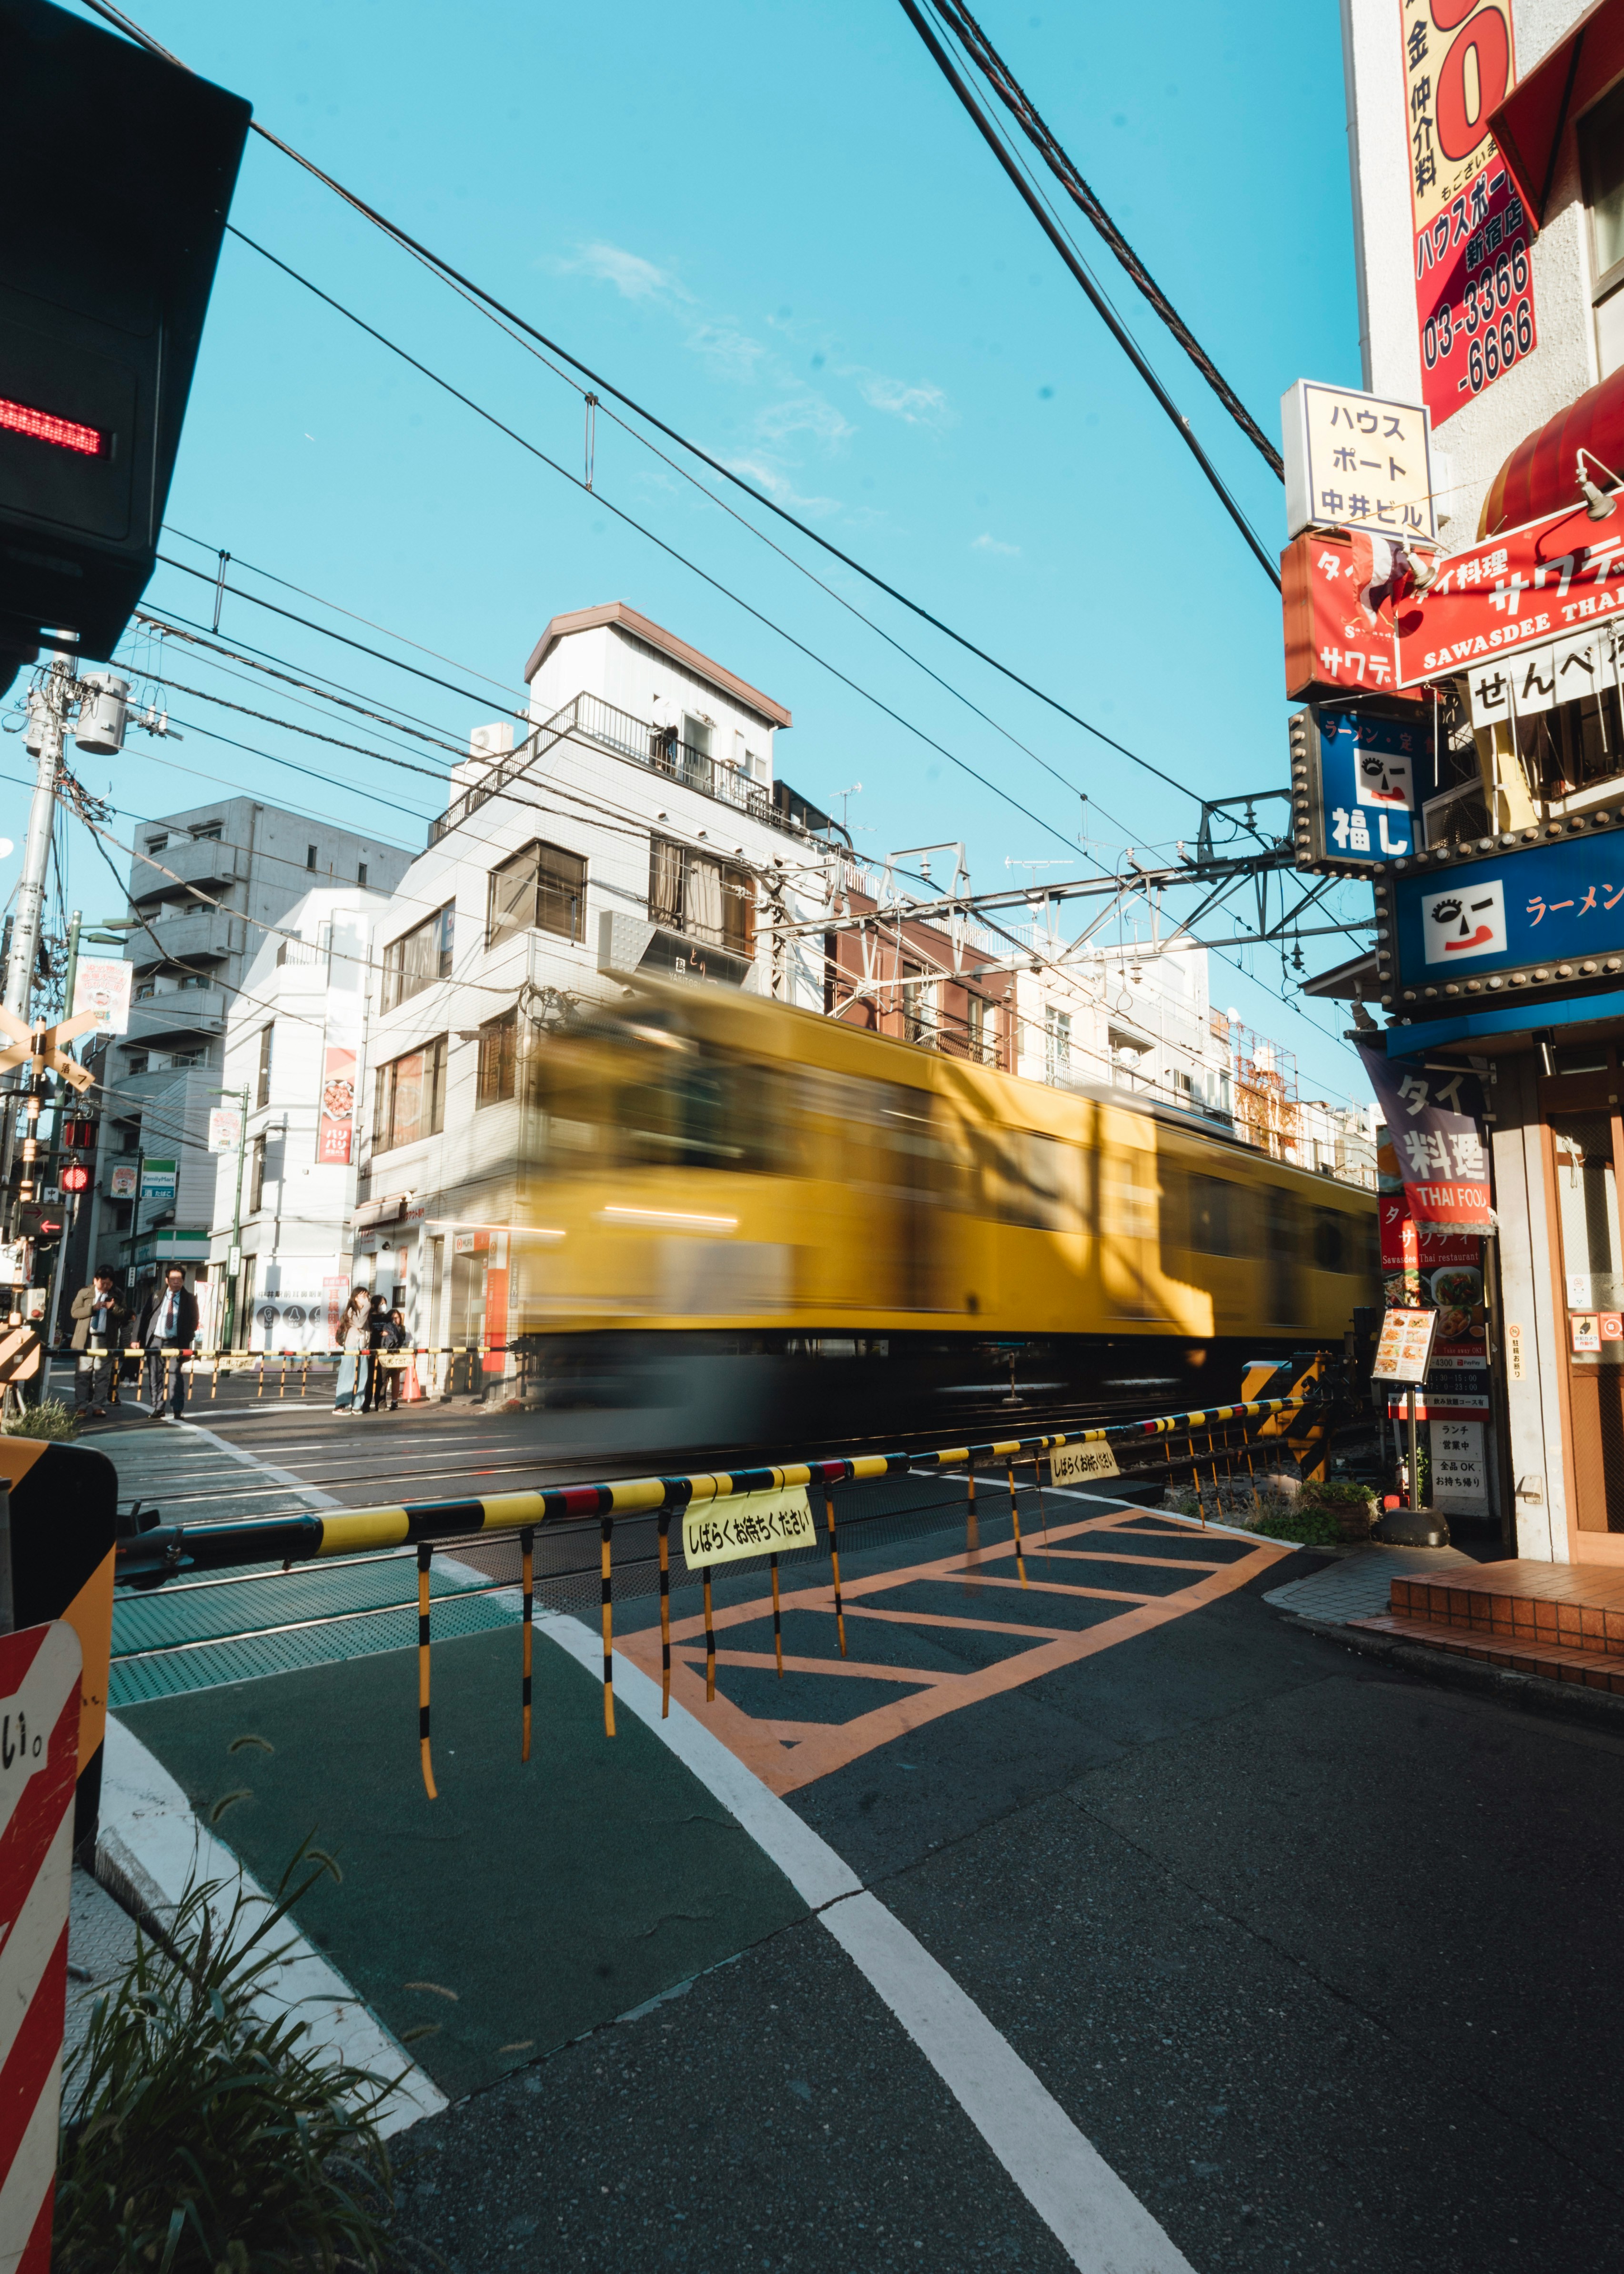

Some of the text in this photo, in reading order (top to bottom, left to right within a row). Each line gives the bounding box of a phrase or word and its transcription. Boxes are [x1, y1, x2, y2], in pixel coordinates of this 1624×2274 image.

[1466, 197, 1523, 273] 新宿店
[1424, 238, 1528, 370] 03-3366
[1458, 297, 1533, 394] -6666
[1331, 405, 1406, 441] ハウス
[1333, 446, 1407, 482] ポート
[1321, 489, 1423, 528] 中井ビル
[1317, 551, 1353, 581] タ
[1423, 613, 1551, 669] SAWASDEE
[1526, 884, 1624, 927] ラーメン
[669, 972, 701, 989] YAKITORI
[1397, 1074, 1464, 1116] タイ
[1403, 1131, 1485, 1180] 料理
[1417, 1187, 1455, 1206] THAI
[1385, 1206, 1412, 1224] タ
[1383, 1252, 1478, 1264] Sawasdee Thai restaurant
[1442, 1425, 1468, 1435] ランチ
[1442, 1440, 1469, 1451] 営業中
[1054, 1452, 1114, 1477] しばらくお待ちください
[1436, 1476, 1479, 1487] お持ち帰り
[1440, 1461, 1475, 1471] 全品 OK
[689, 1509, 809, 1555] しばらくお待ちください
